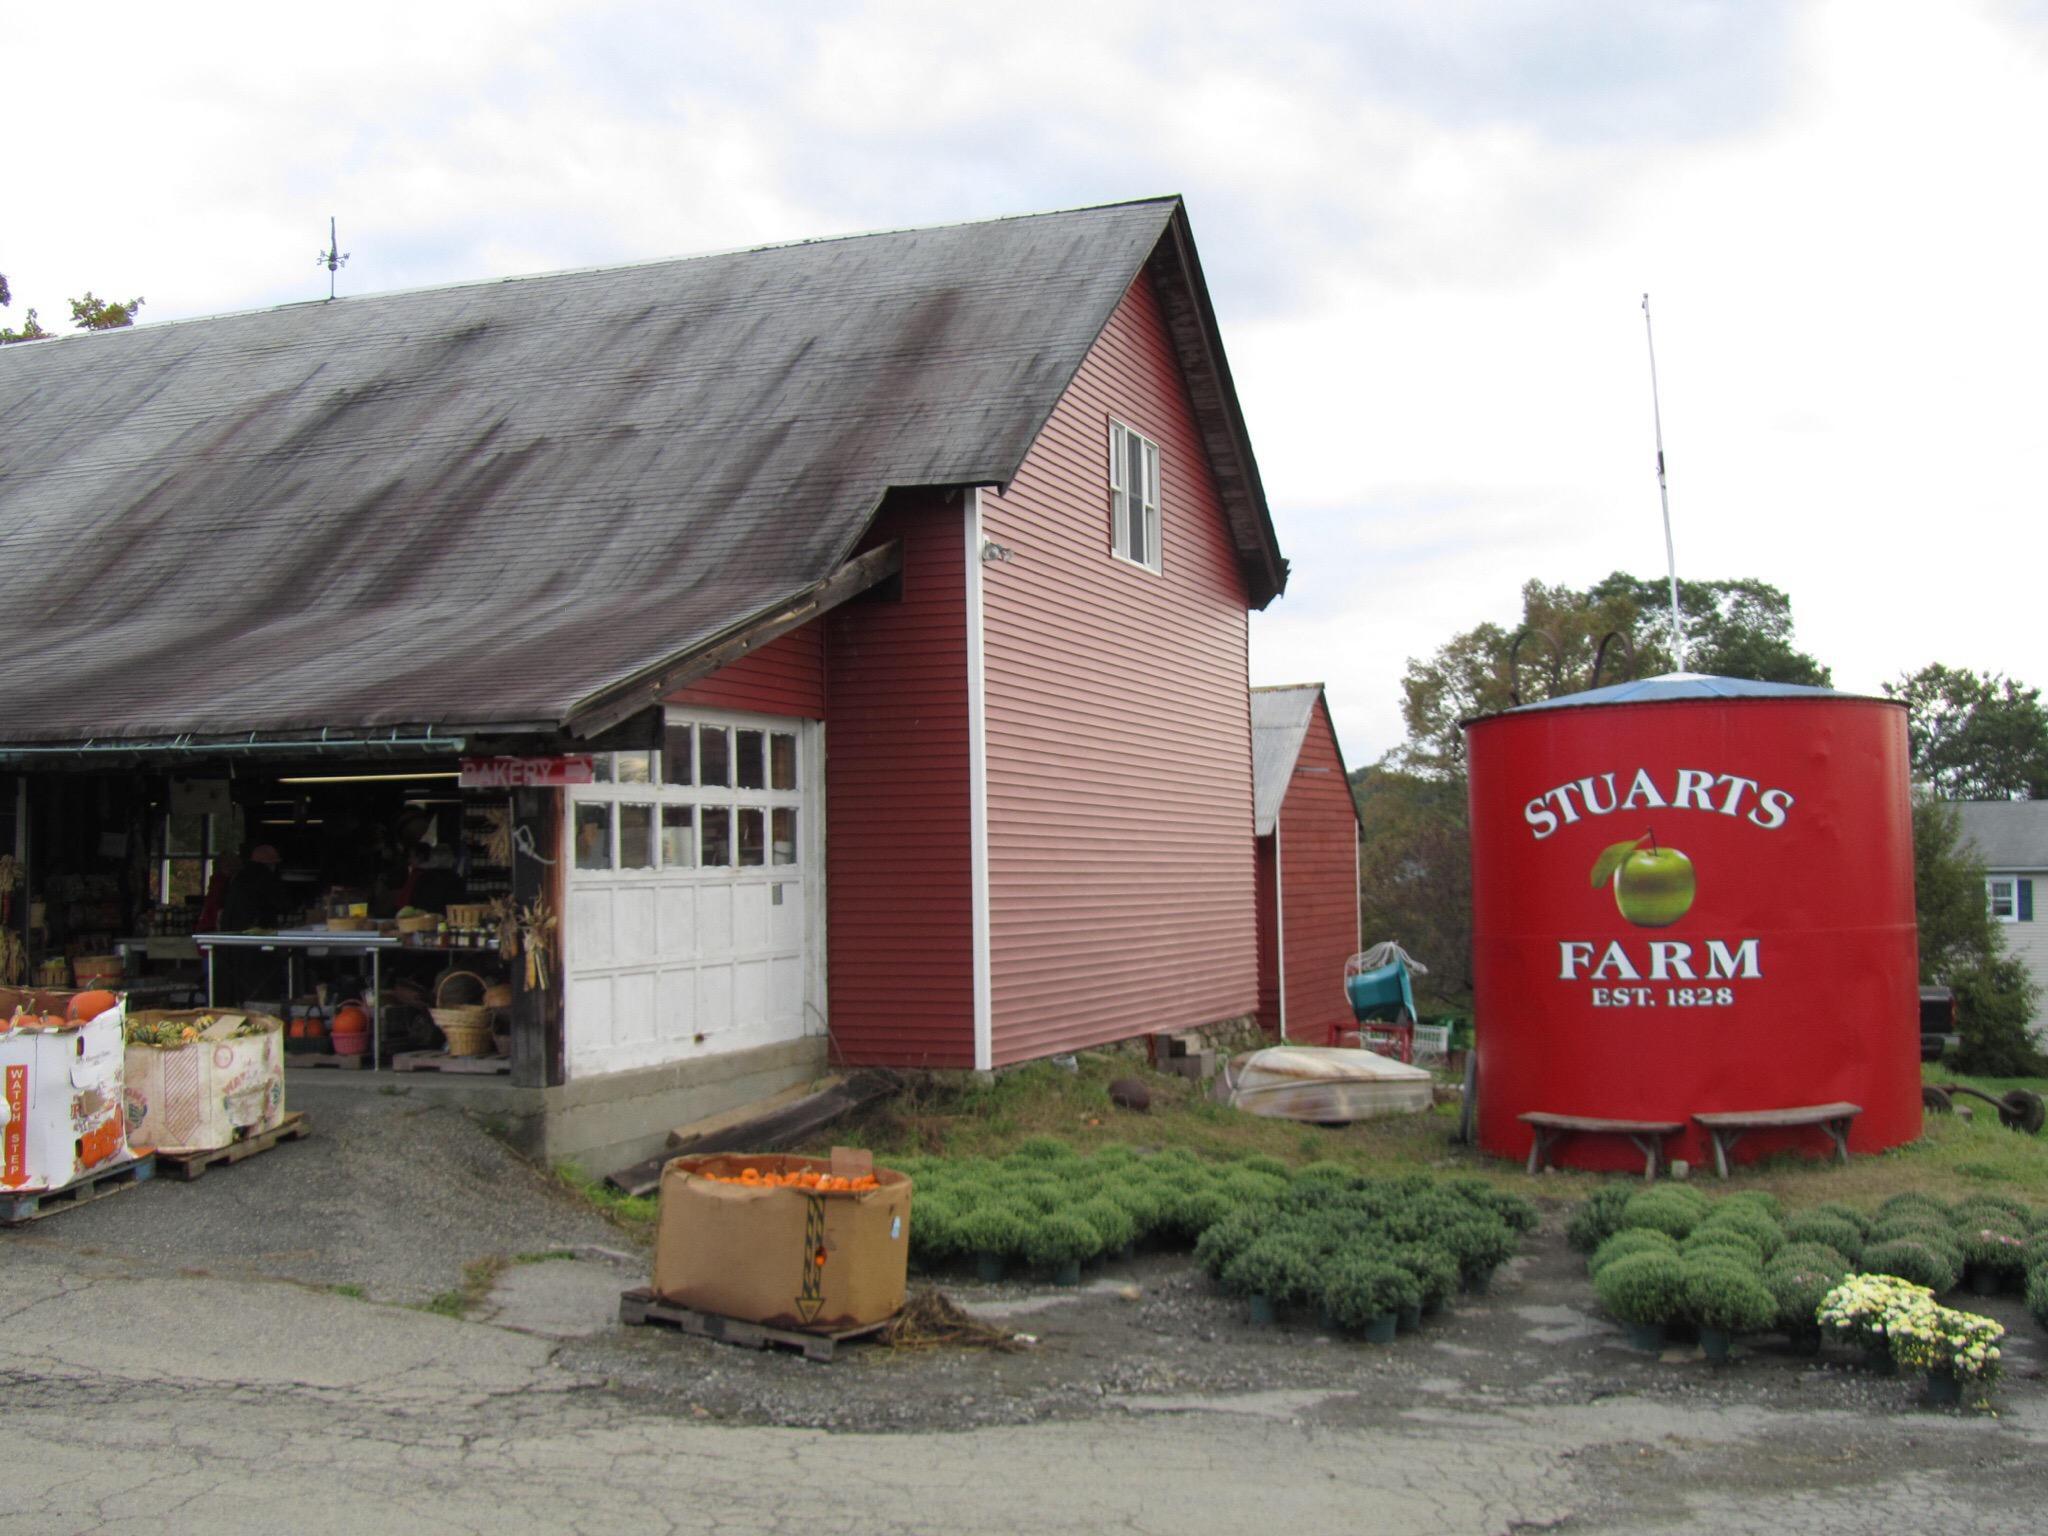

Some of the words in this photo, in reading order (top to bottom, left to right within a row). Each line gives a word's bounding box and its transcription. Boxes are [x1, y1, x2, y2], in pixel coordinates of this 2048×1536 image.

[463, 761, 553, 787] BAKERY
[1524, 768, 1795, 840] STUARTS
[1558, 939, 1763, 980] FARM
[1592, 987, 1656, 1007] EST.
[1666, 987, 1735, 1006] 1828
[11, 1069, 23, 1122] WATCH
[11, 1134, 20, 1175] STEP
